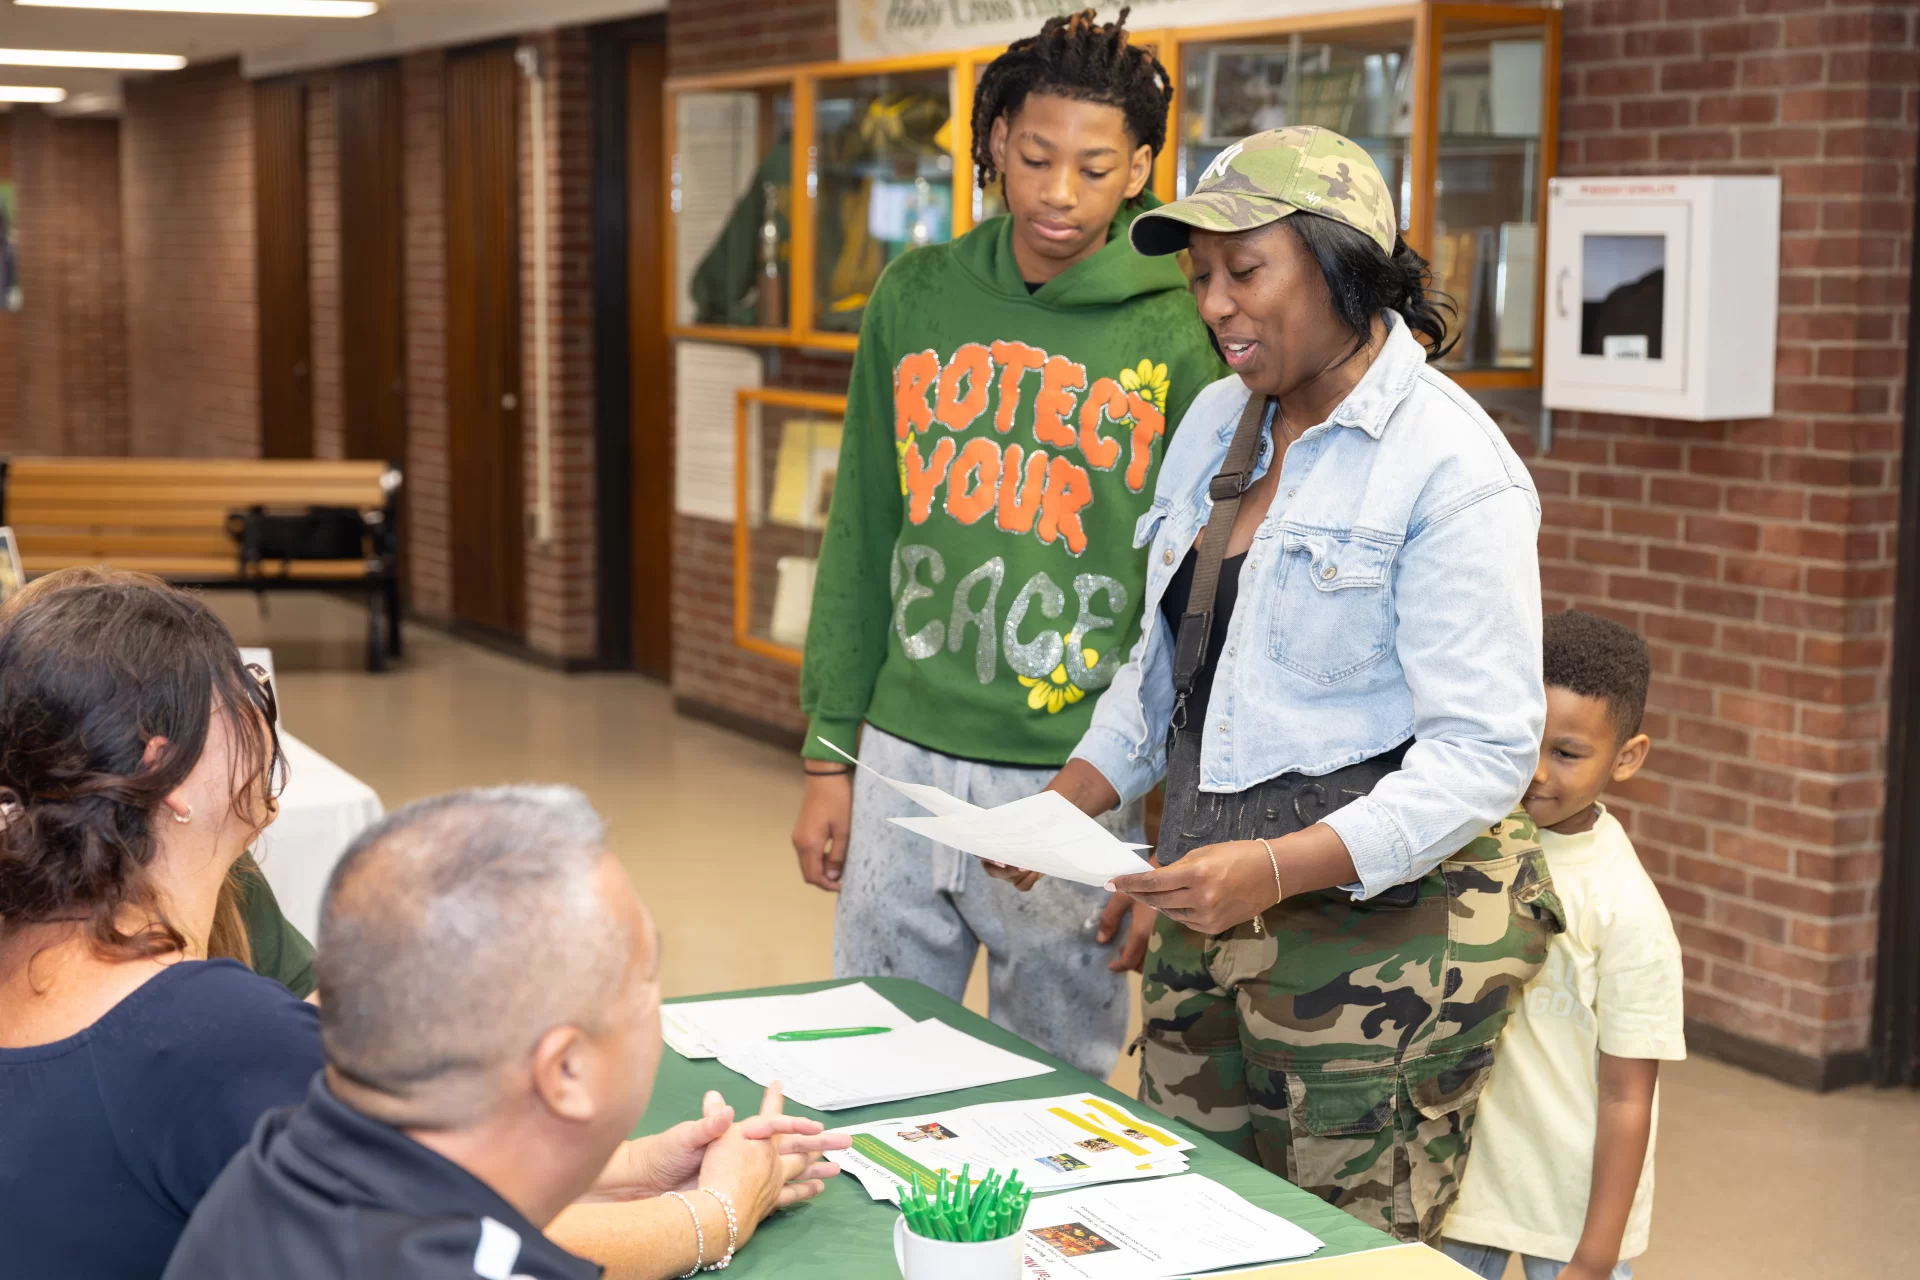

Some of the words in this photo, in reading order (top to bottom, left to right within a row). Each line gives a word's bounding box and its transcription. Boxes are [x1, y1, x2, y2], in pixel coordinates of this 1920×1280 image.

[892, 338, 1166, 493] ROTECT
[904, 435, 1094, 557] YOUR
[890, 543, 1128, 690] EACE
